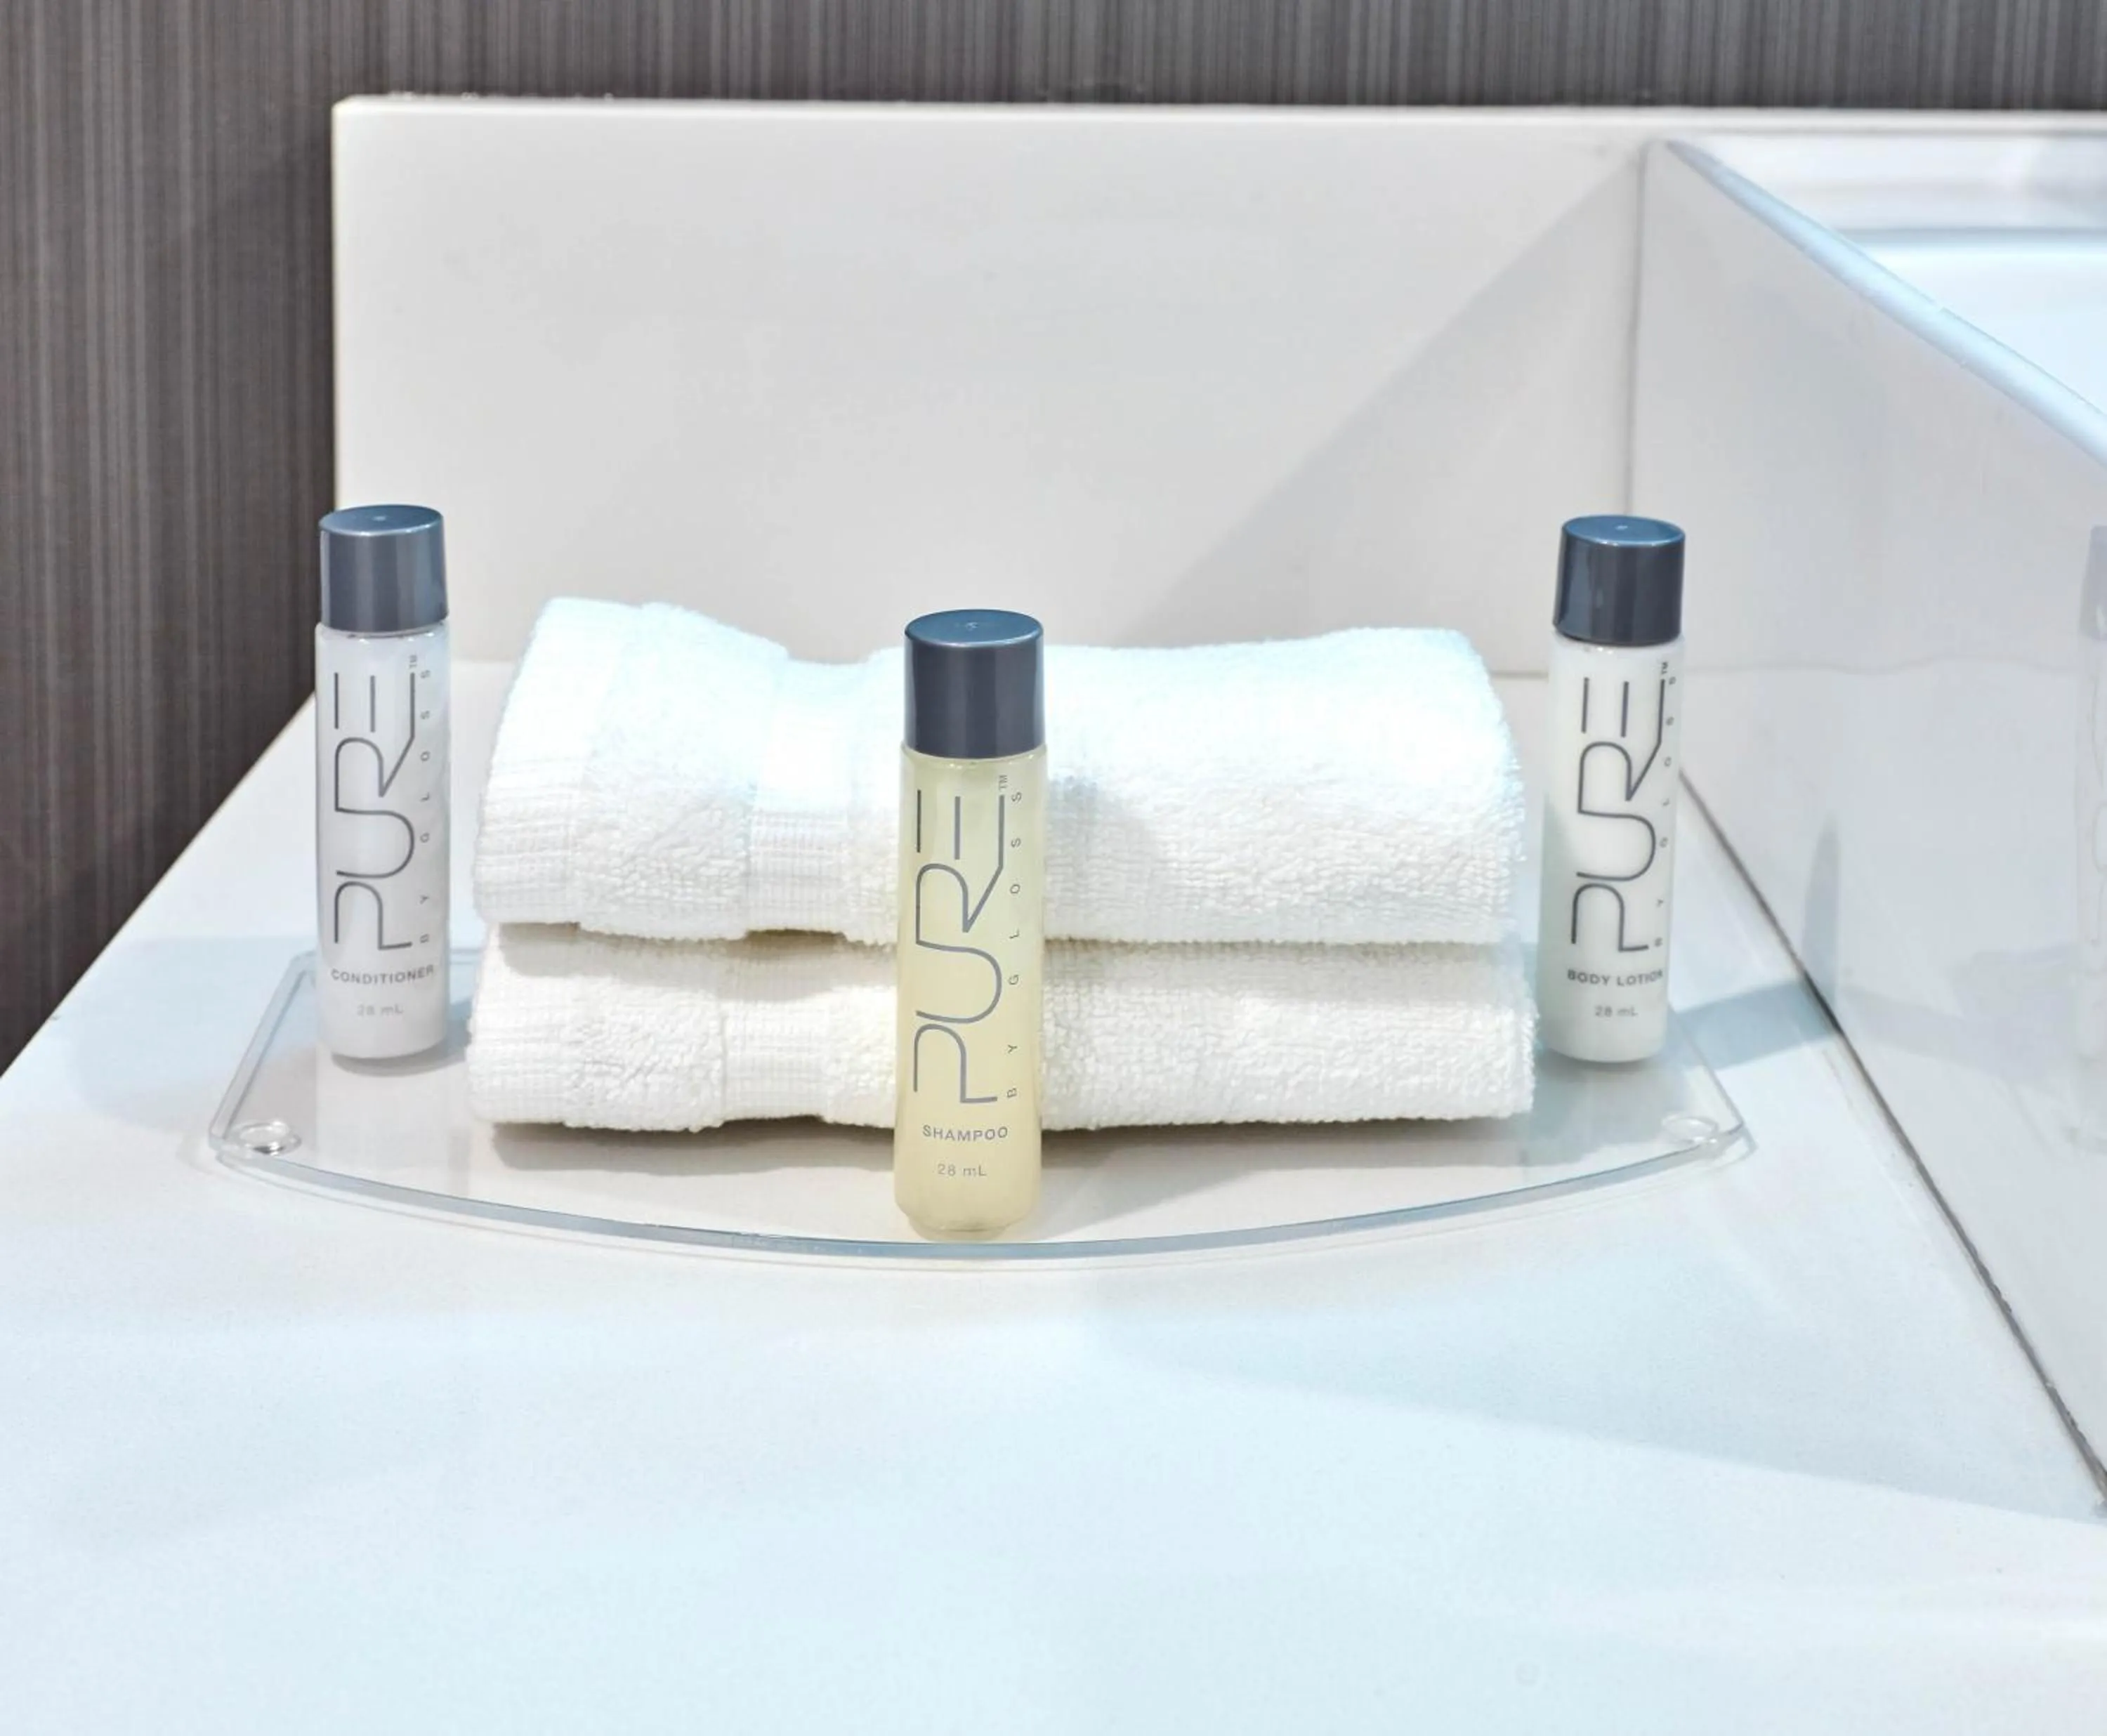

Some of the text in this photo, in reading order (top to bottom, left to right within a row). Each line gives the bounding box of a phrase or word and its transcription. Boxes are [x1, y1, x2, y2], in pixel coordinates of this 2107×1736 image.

[421, 669, 431, 844] GLOSS
[334, 672, 414, 951] PURE
[1571, 676, 1665, 953] PURE
[914, 789, 1004, 1105] PURE
[1006, 791, 1023, 1099] BY GLOSS
[330, 964, 434, 985] CONDITIONER
[1567, 968, 1663, 987] BODY LOTION
[357, 1004, 404, 1016] 28 mL
[1595, 1006, 1639, 1018] 28 mL
[922, 1124, 1009, 1142] SHAMPOO
[937, 1163, 987, 1177] 28 mL
